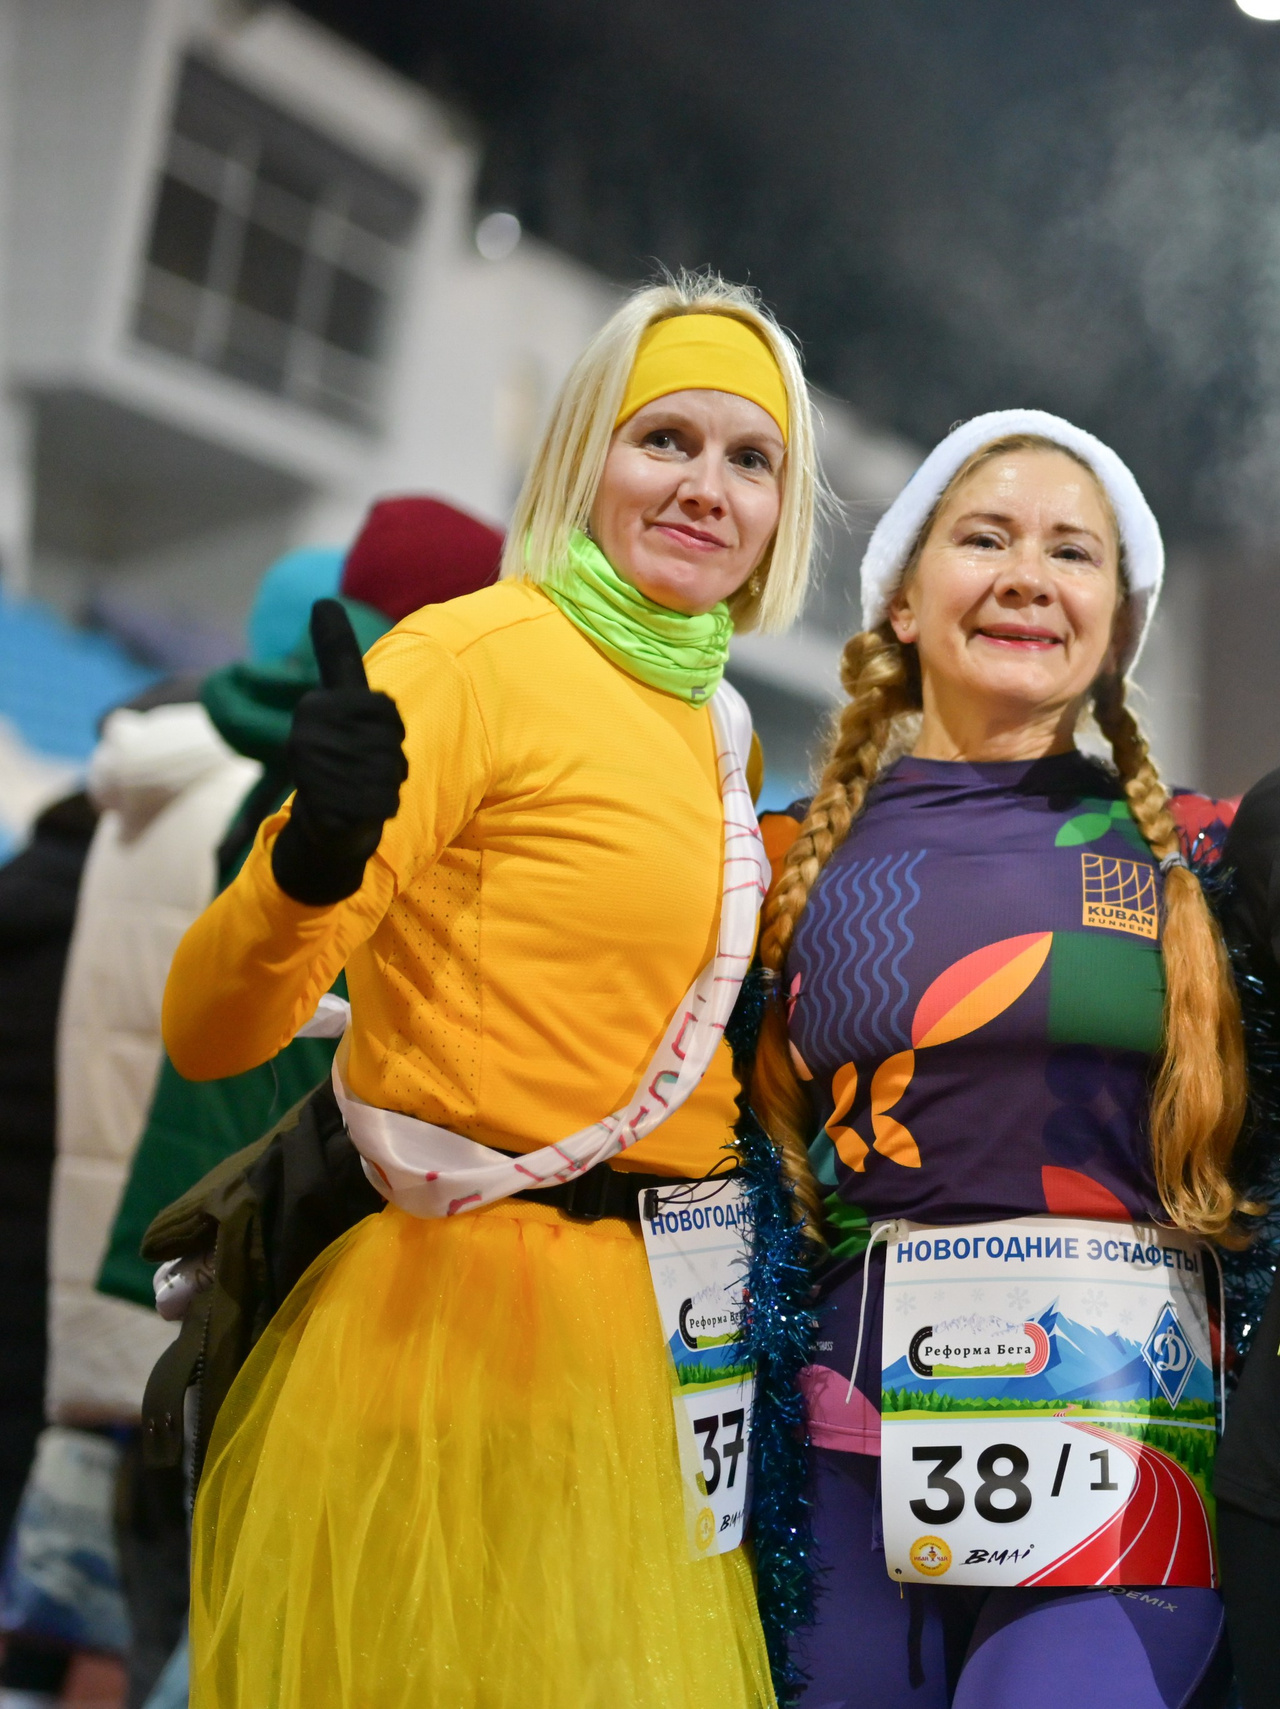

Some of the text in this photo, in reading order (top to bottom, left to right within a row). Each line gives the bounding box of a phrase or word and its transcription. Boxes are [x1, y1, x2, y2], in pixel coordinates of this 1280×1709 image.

[1088, 906, 1153, 927] KUBAN
[1088, 917, 1152, 935] RUNNERS
[896, 1236, 1201, 1274] НОВОГОДНИЕ ЭСТАФЕТЫ
[689, 1315, 727, 1330] Реформа
[925, 1344, 1032, 1359] Реформа Бега
[693, 1408, 745, 1497] 37
